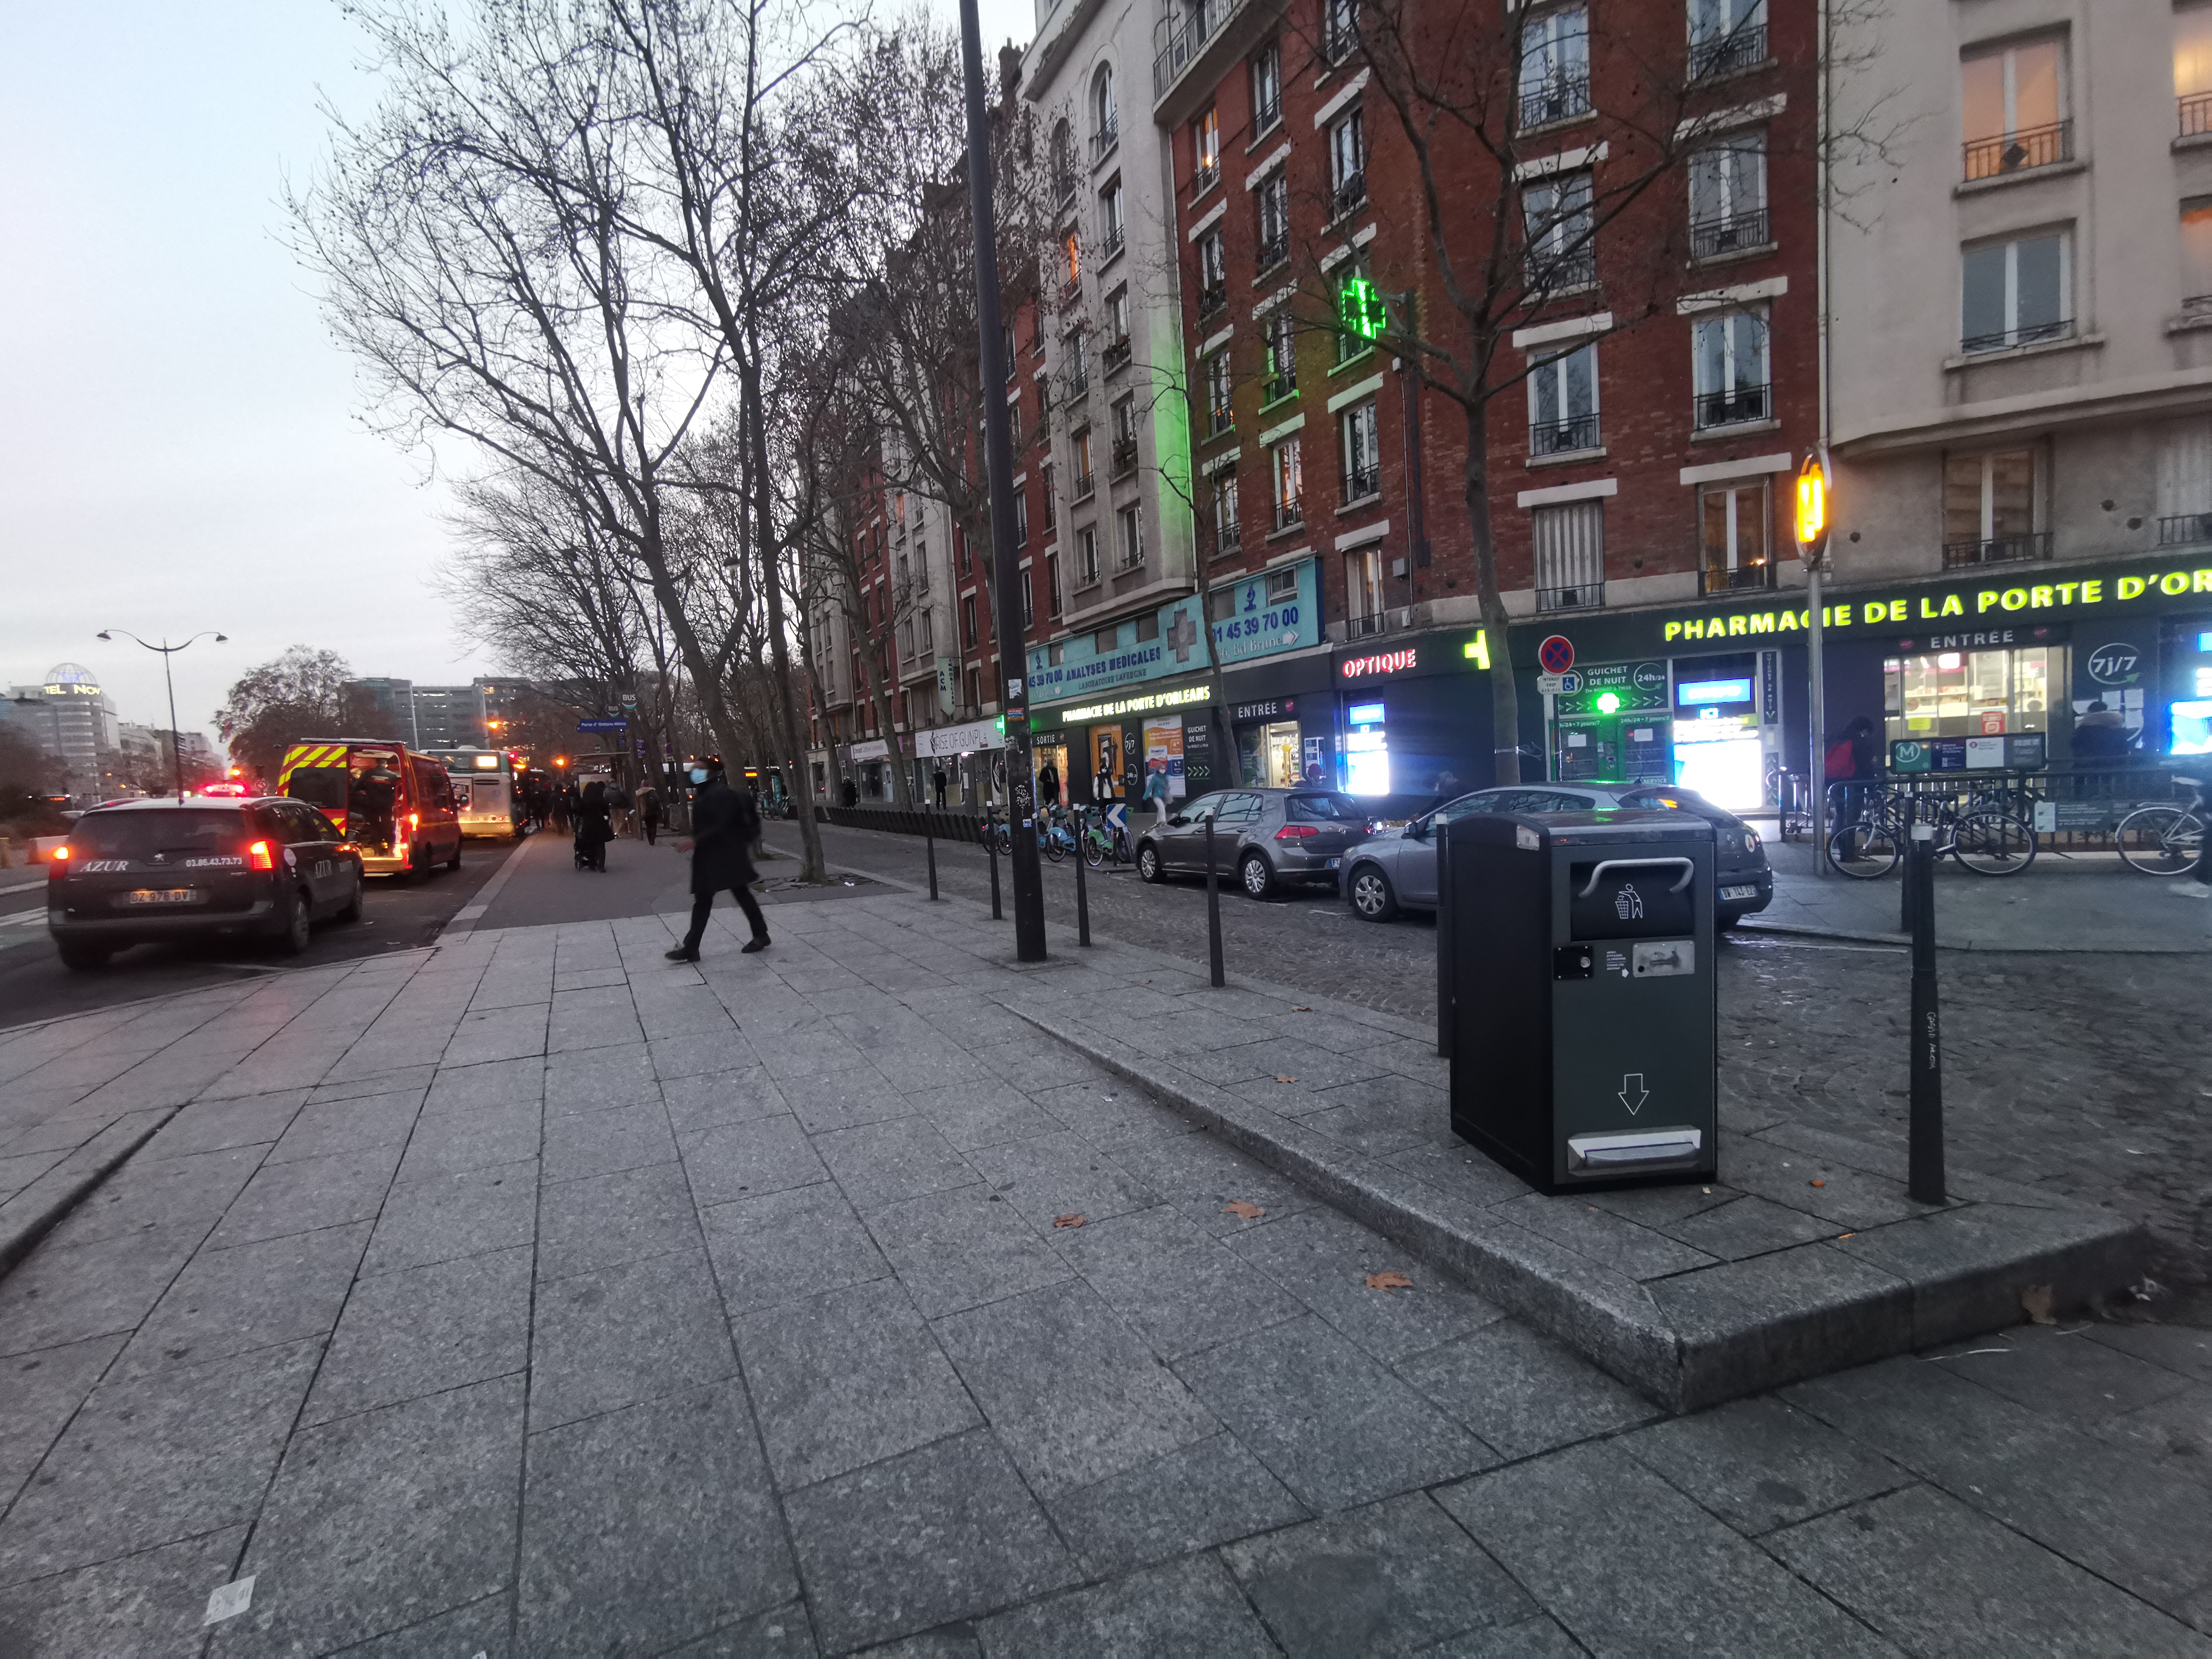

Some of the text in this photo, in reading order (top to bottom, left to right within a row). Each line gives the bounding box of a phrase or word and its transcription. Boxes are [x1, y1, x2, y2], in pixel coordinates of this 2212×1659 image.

[1863, 599, 1908, 624] DE
[1920, 594, 1964, 619] LA
[1977, 579, 2103, 613] PORTE
[1227, 621, 1241, 639] 45
[1244, 617, 1259, 636] 39
[1262, 611, 1279, 631] 70
[1282, 606, 1299, 627] 00
[1931, 630, 2014, 649] ENTRÉE
[1066, 661, 1106, 681] ANALYSES
[1109, 646, 1160, 671] MEDICALES
[1343, 648, 1416, 678] OPTIQUE
[1587, 666, 1628, 676] GUICHET
[2092, 656, 2137, 676] 7j/7
[1116, 668, 1147, 681] LAVERGNE
[1589, 676, 1627, 686] DE NUIT
[1637, 673, 1665, 682] 24h/24
[1103, 702, 1115, 716] DE
[1116, 701, 1126, 713] LA
[1127, 696, 1155, 712] PORTE
[1156, 686, 1211, 708] D'ORLEANS
[1238, 702, 1277, 718] ENTRÉE
[1187, 725, 1206, 734] GUICHET
[1036, 734, 1055, 745] SORTIE
[80, 860, 130, 872] AZUR
